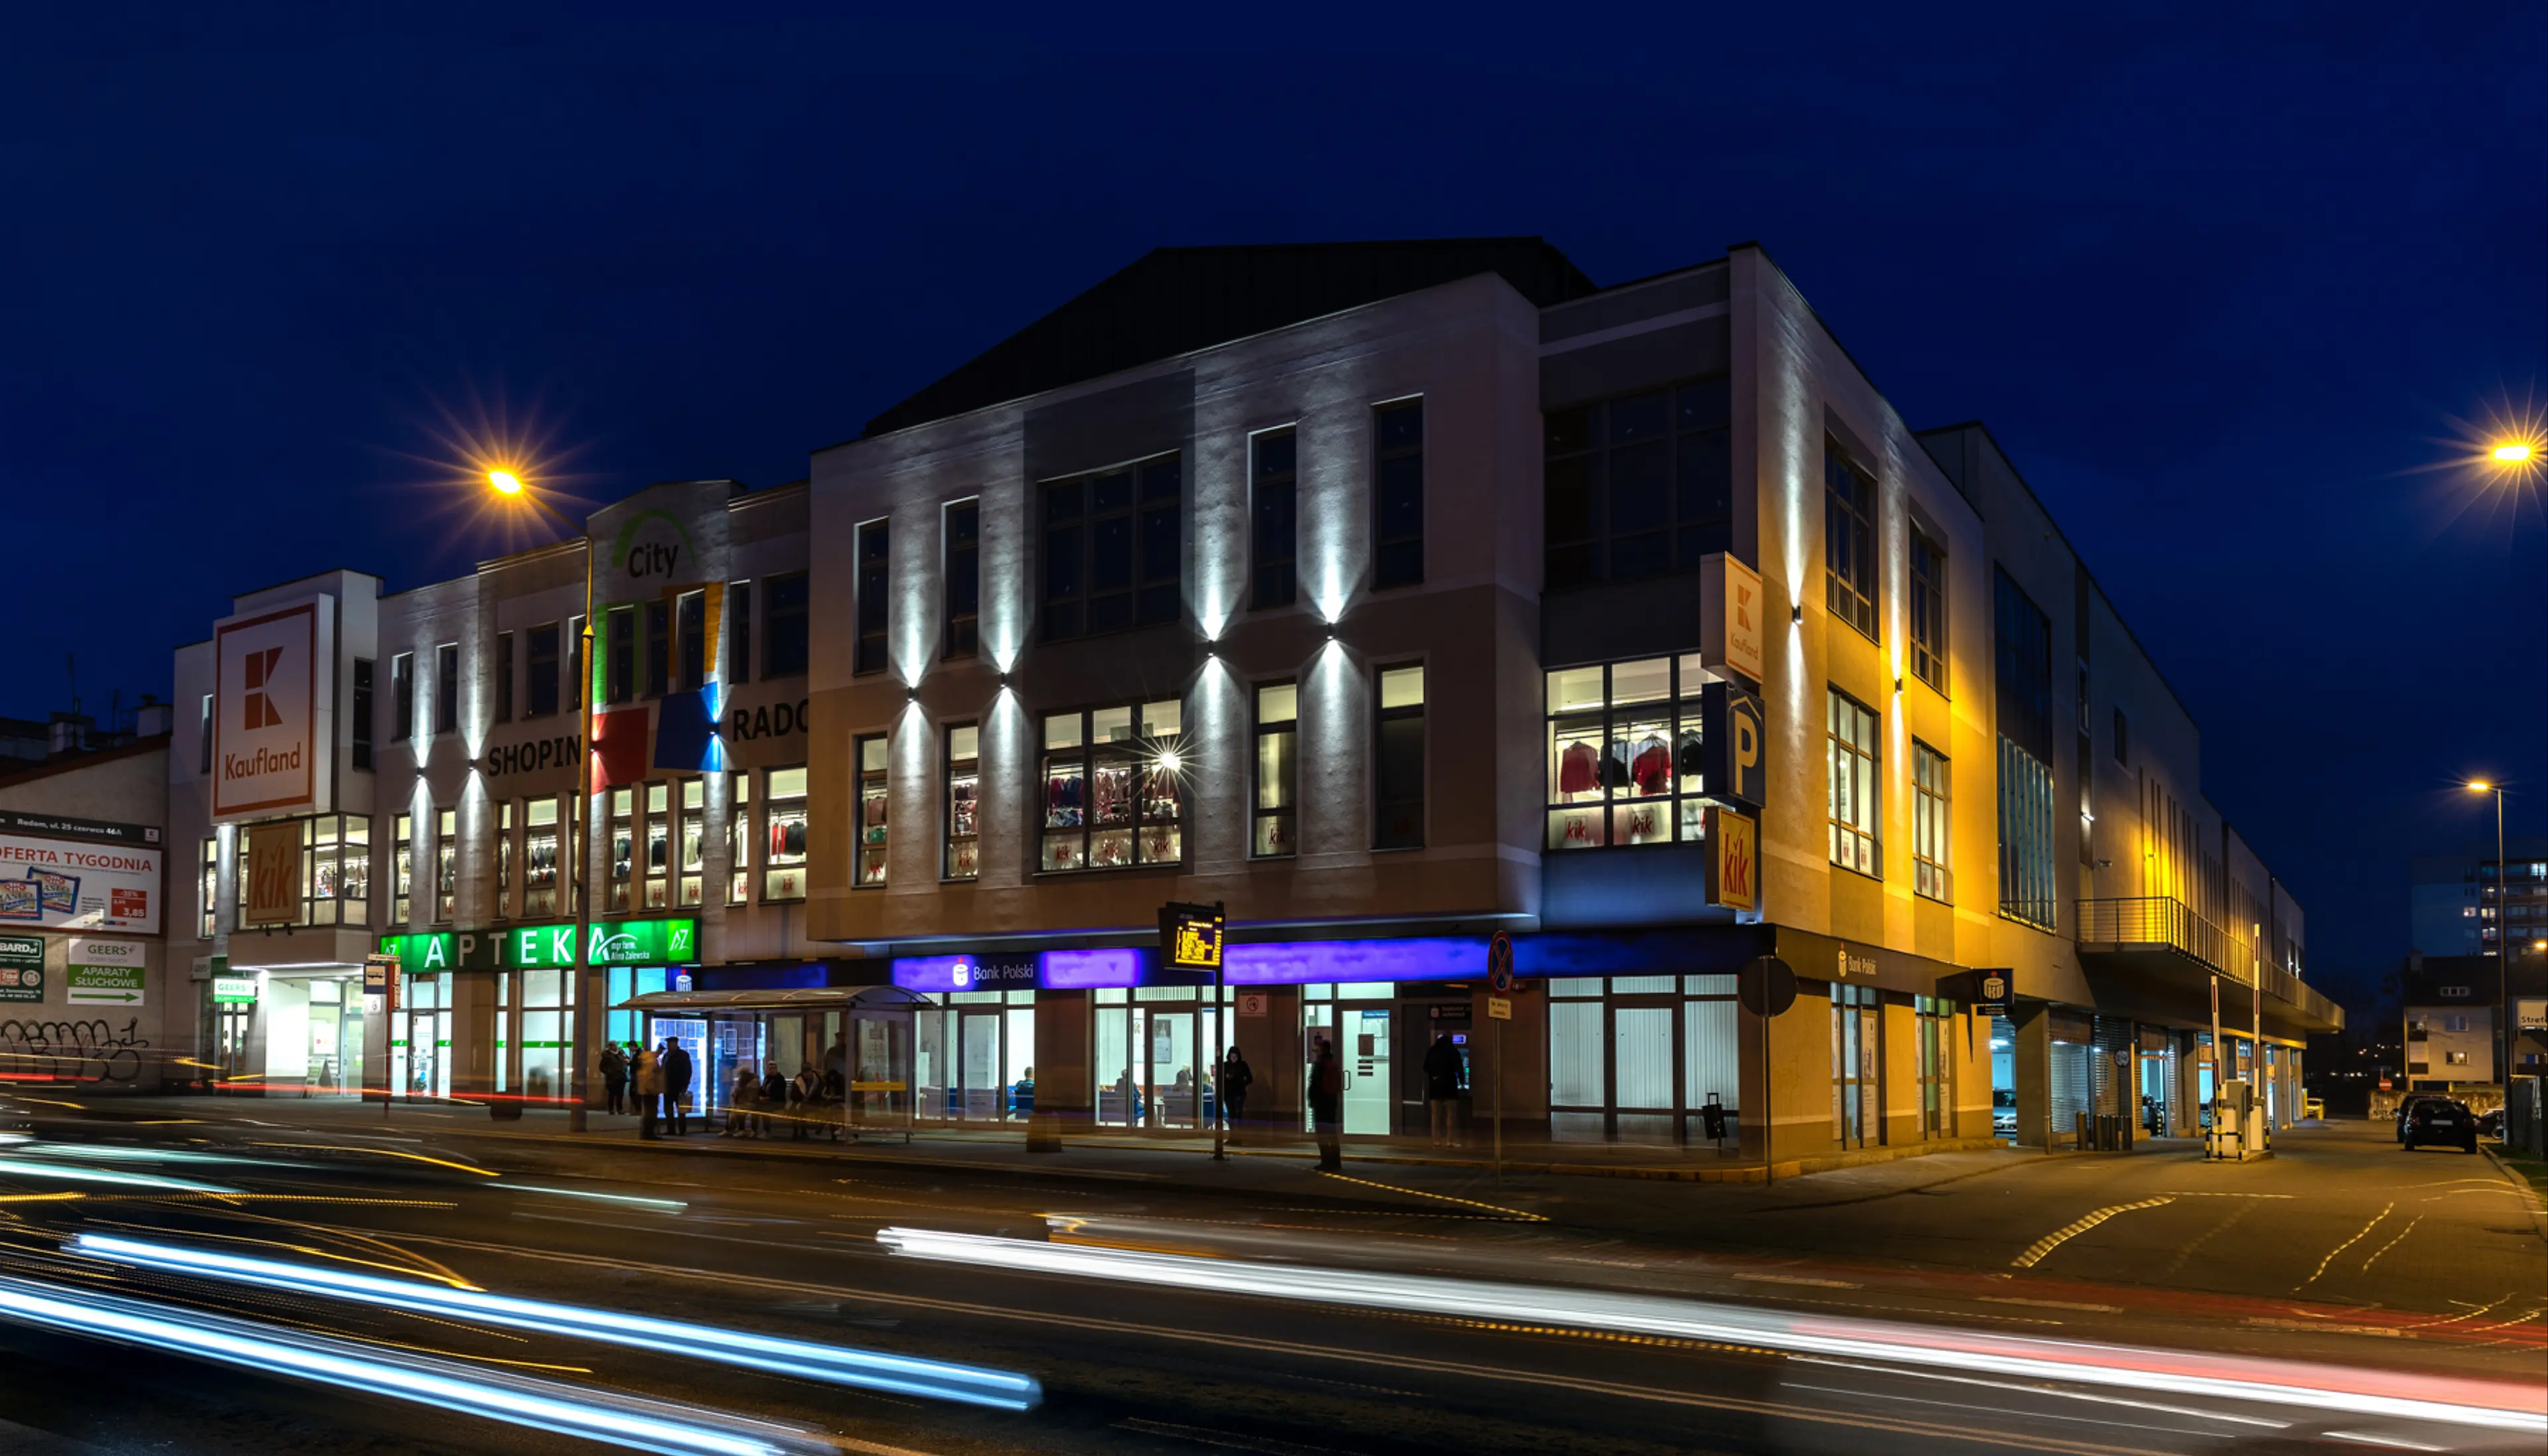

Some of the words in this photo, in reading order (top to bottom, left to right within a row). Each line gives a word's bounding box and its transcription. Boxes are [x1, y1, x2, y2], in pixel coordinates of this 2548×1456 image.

[628, 544, 679, 579] City
[1731, 631, 1758, 661] Kaufland
[488, 734, 582, 777] SHOPIN
[733, 698, 809, 743] RADO
[1734, 709, 1758, 796] P
[225, 742, 301, 781] Kaufland
[0, 846, 58, 864] FERTA
[64, 852, 153, 872] TYGODNIA
[251, 834, 293, 910] kik
[1725, 827, 1748, 897] kik
[88, 944, 127, 955] GEERS
[424, 927, 610, 968] APTEKA
[75, 976, 138, 988] SŁUCHOWE
[82, 967, 132, 977] APARATY
[218, 984, 246, 992] GEERS
[973, 965, 1000, 980] Bank
[1003, 964, 1034, 979] Polski
